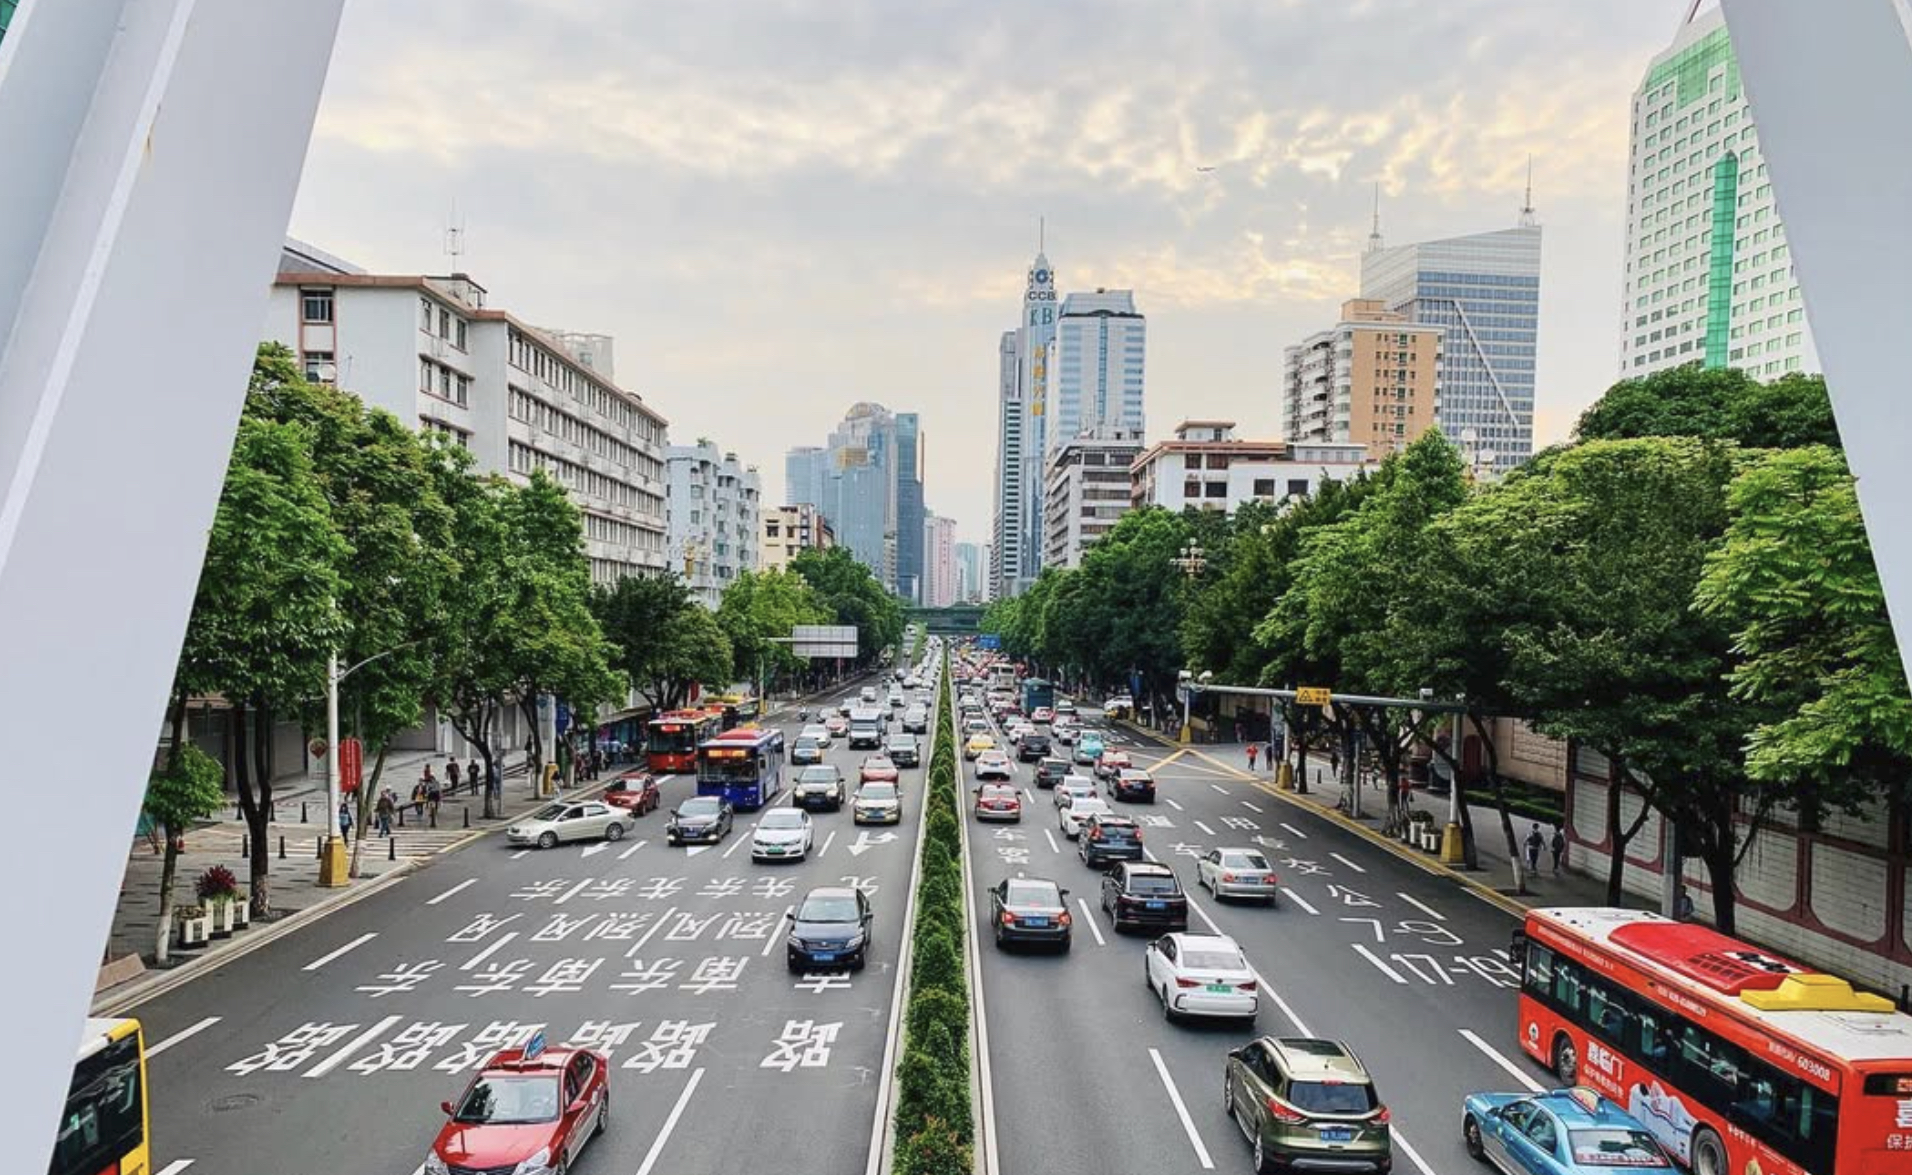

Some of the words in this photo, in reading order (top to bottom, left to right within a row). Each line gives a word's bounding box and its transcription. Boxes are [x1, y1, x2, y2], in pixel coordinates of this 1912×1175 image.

[1028, 290, 1056, 301] CCB
[1338, 918, 1463, 945] 7-9
[1391, 954, 1521, 988] 17-19
